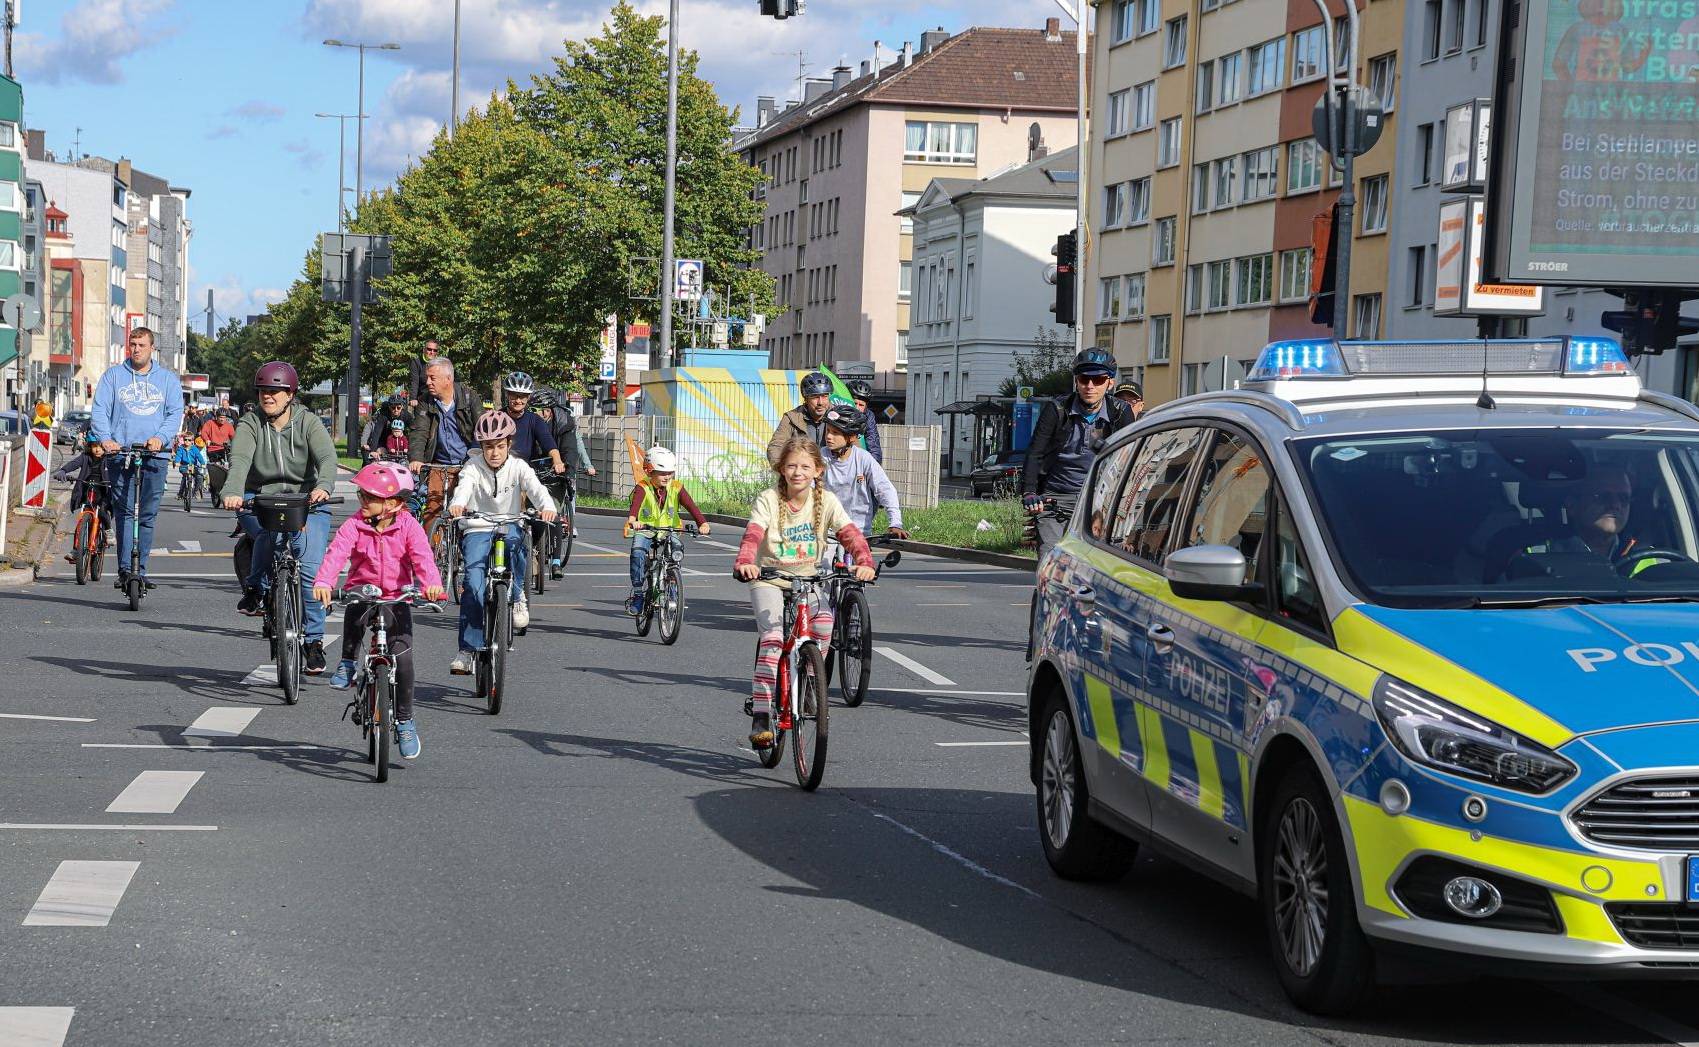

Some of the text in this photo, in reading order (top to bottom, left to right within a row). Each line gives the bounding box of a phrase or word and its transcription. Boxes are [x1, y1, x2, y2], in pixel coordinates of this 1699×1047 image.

[1562, 132, 1591, 151] Bei
[1560, 163, 1593, 180] aus
[1599, 161, 1630, 181] der
[1557, 188, 1698, 212] Strom, ohne zu
[1491, 286, 1534, 296] vermieten
[1168, 650, 1232, 715] POLIZEI
